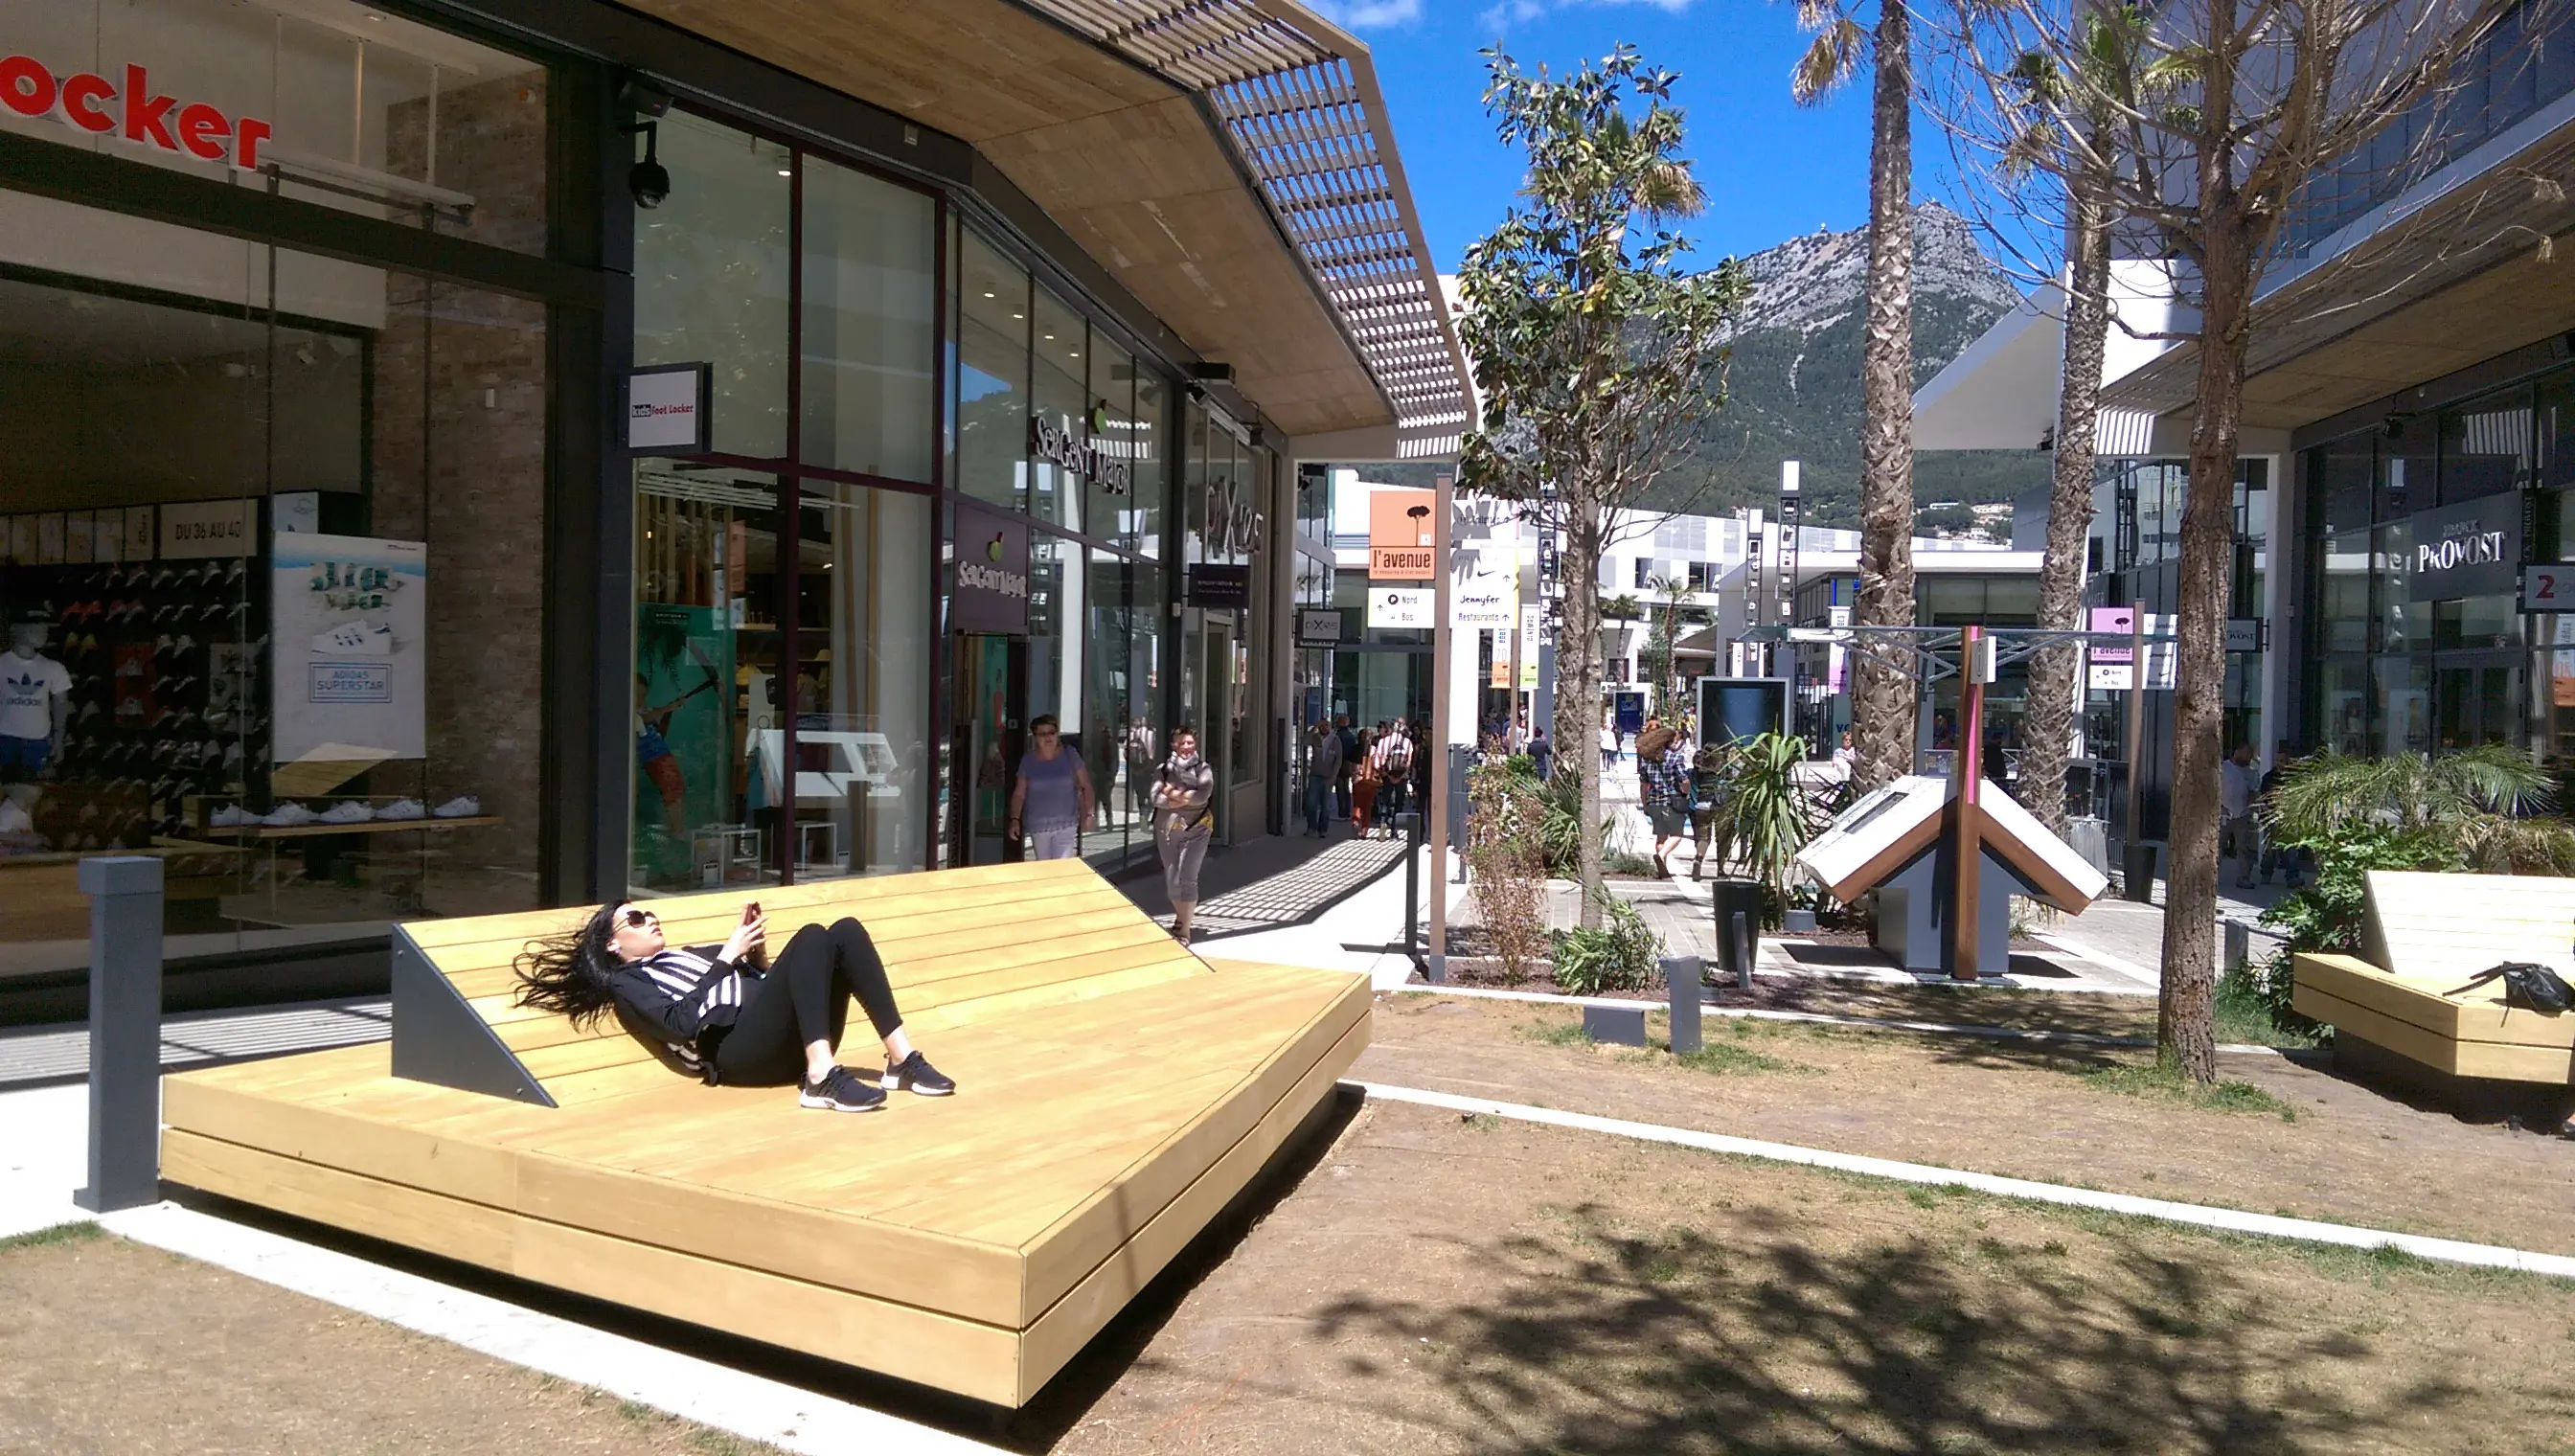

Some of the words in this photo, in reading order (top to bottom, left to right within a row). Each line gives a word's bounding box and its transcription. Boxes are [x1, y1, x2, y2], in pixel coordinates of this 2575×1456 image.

[0, 55, 272, 171] ocker
[1374, 549, 1431, 569] l'avenue
[2418, 531, 2506, 573] PROVOST
[1460, 595, 1500, 606] Jennyfer
[1458, 612, 1499, 622] Restaurants
[316, 680, 384, 691] SUPERSTAR
